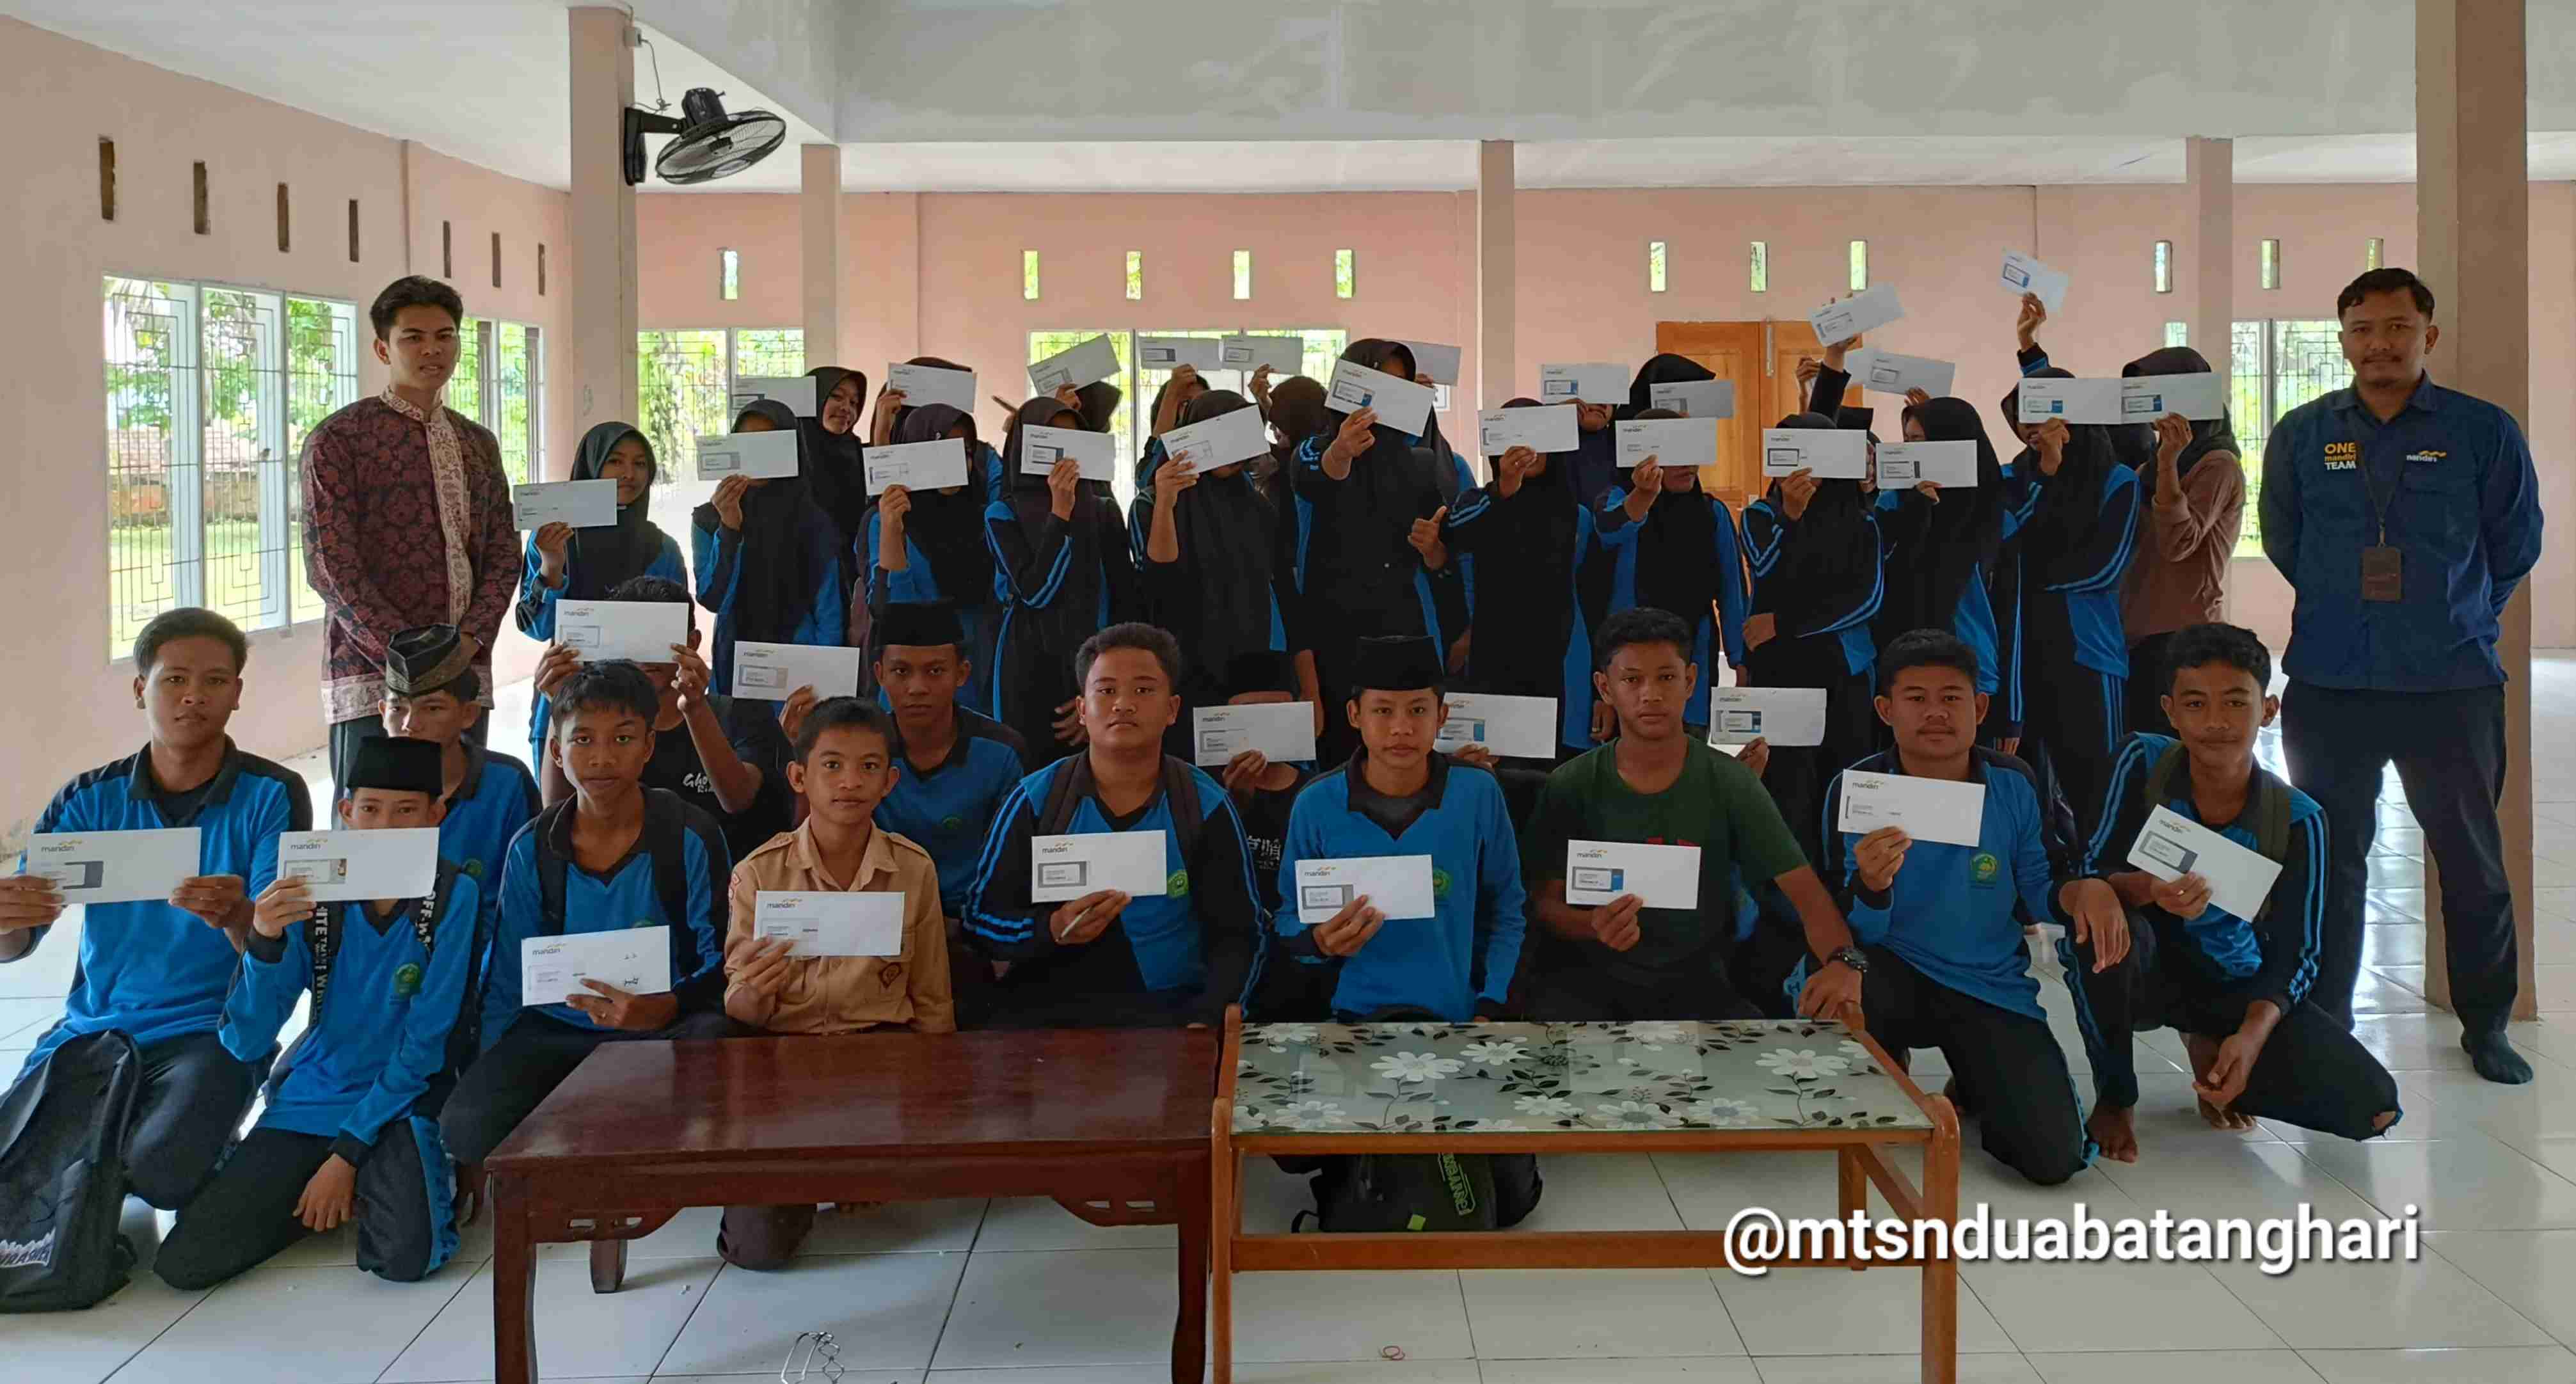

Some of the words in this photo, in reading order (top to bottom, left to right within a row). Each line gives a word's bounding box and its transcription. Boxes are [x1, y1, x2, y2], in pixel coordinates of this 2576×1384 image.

[2325, 442, 2355, 454] ONE
[2325, 461, 2356, 470] TEAM
[682, 772, 708, 788] Gho
